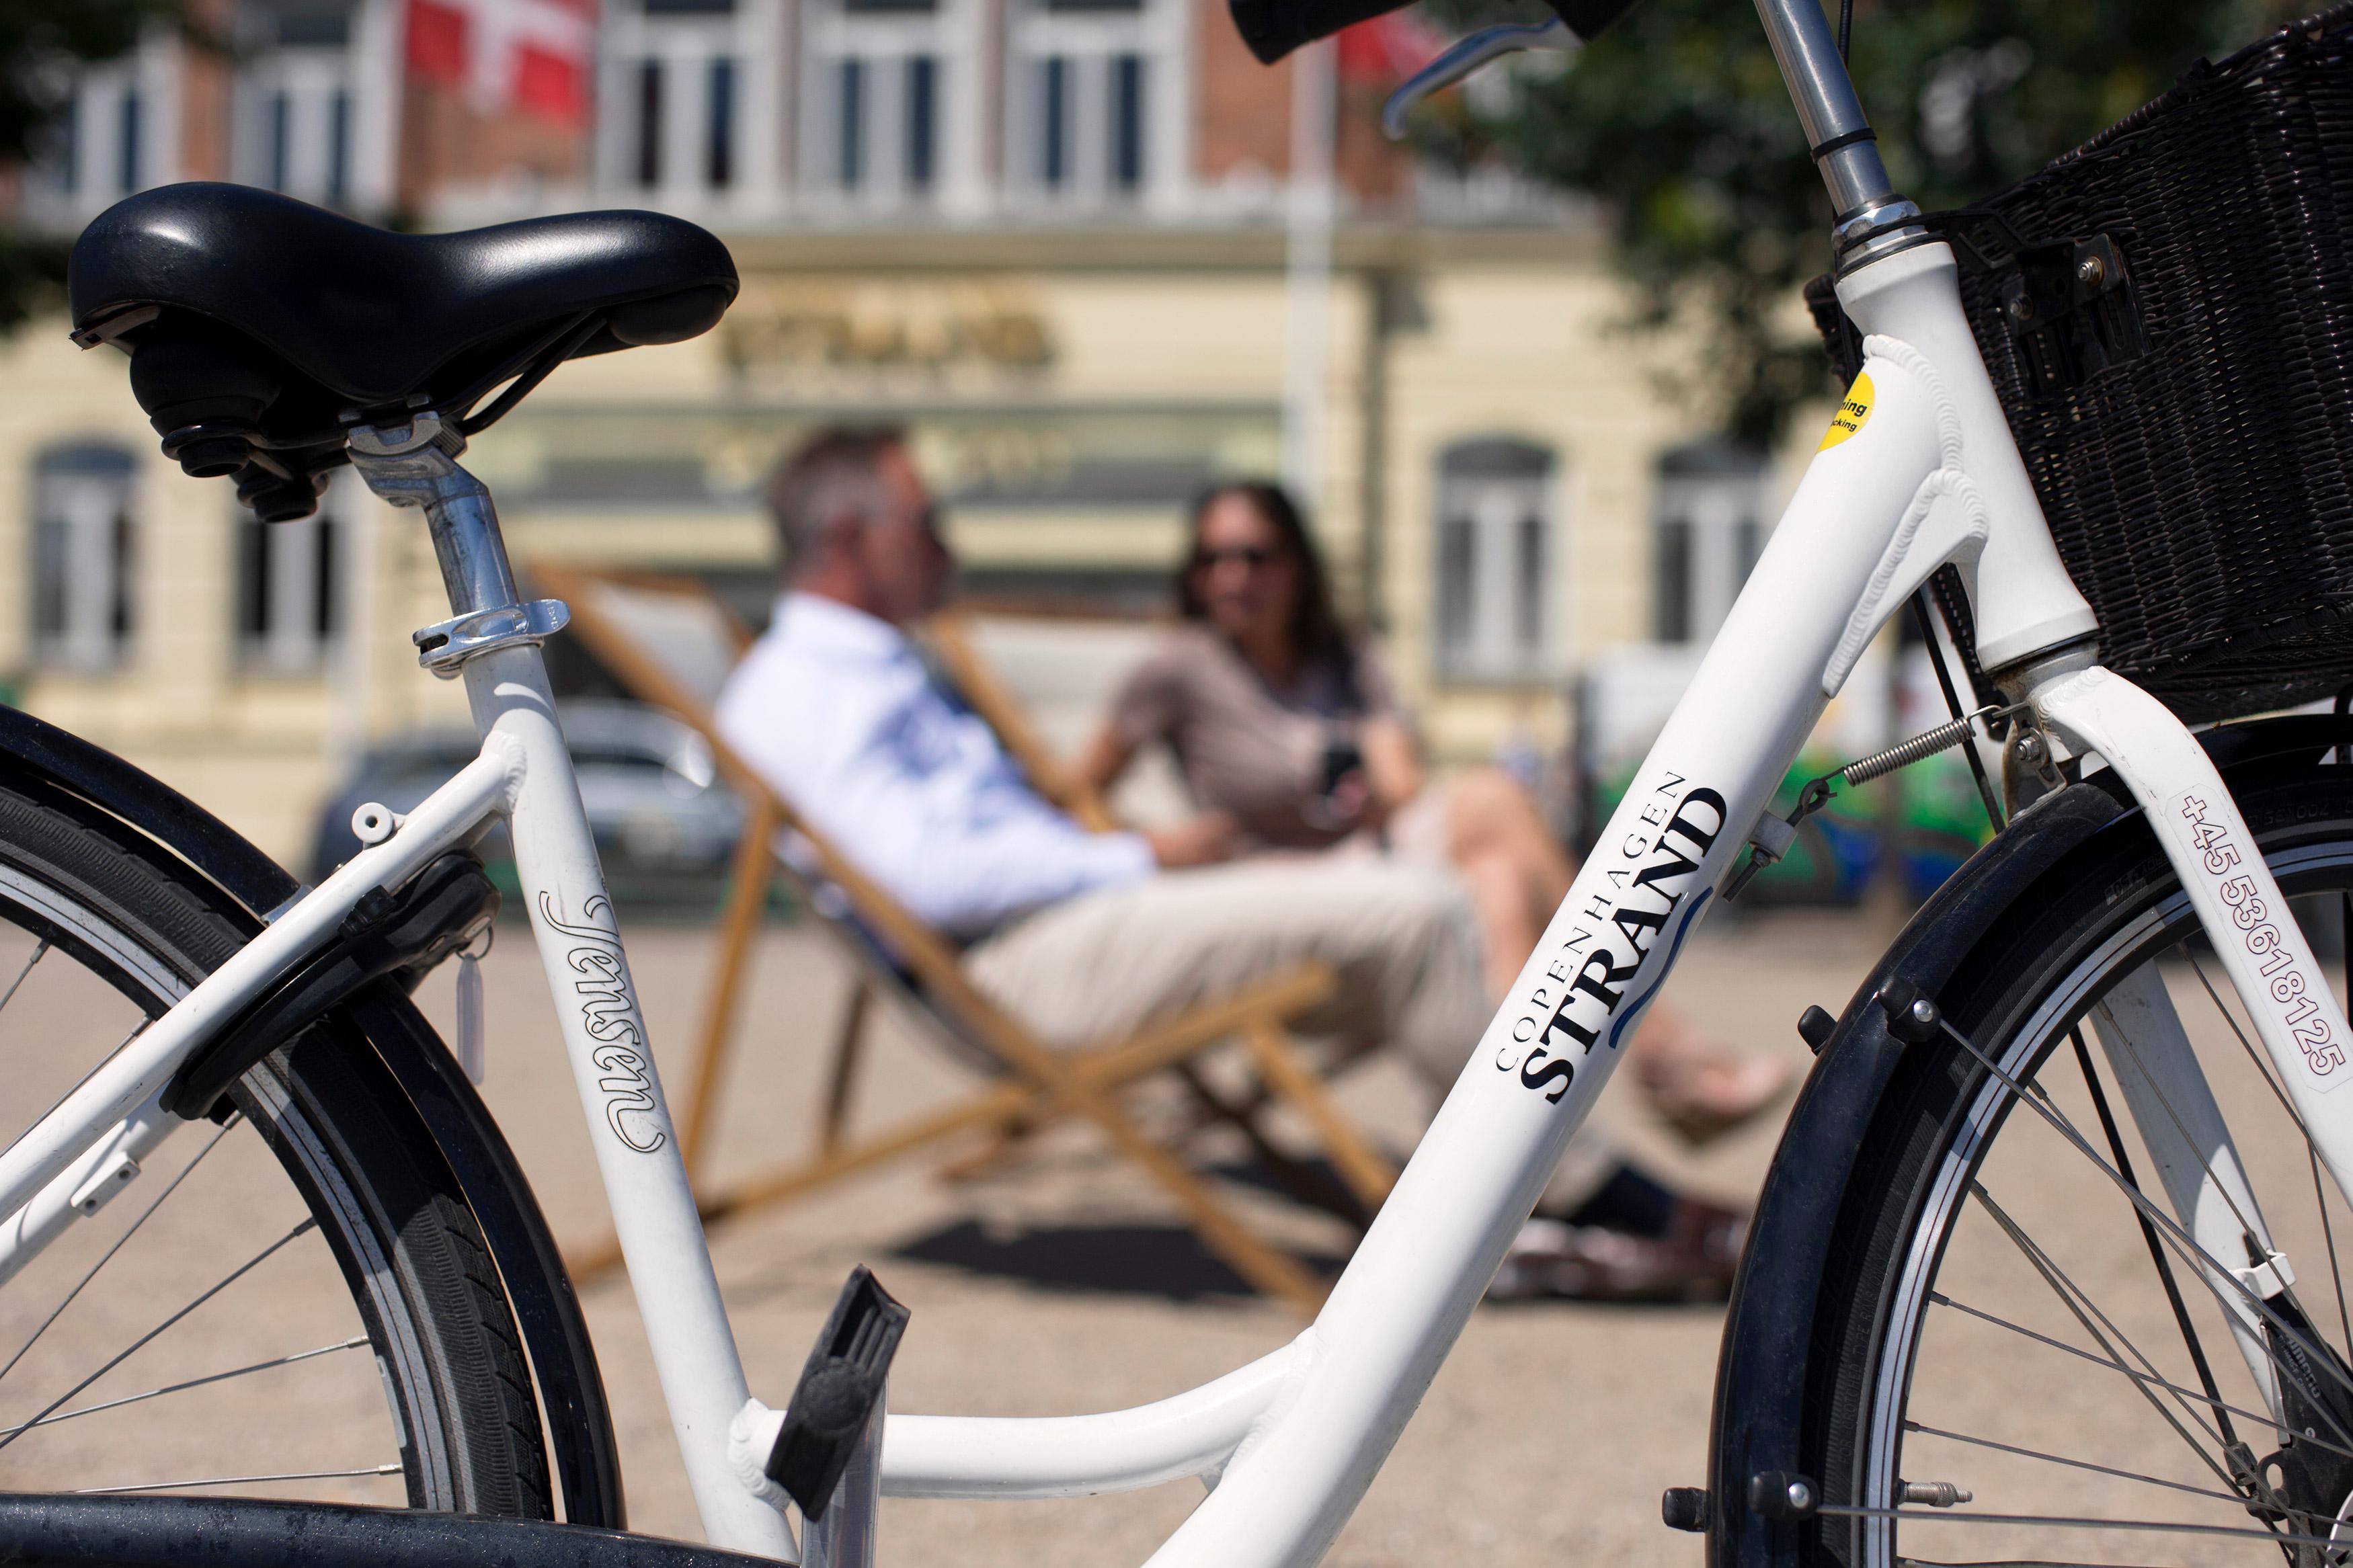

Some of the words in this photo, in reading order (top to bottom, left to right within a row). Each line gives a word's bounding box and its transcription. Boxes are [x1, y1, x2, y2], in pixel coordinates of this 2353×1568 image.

[1831, 418, 1857, 432] cking
[539, 891, 665, 1153] Jensen
[1496, 771, 1686, 1071] COPENHAGEN
[1521, 787, 1726, 1104] STRAND
[2182, 796, 2241, 874] +45
[2221, 875, 2346, 1075] 53618125
[1852, 1326, 1870, 1356] TYPE
[2284, 1327, 2320, 1399] HIMANO
